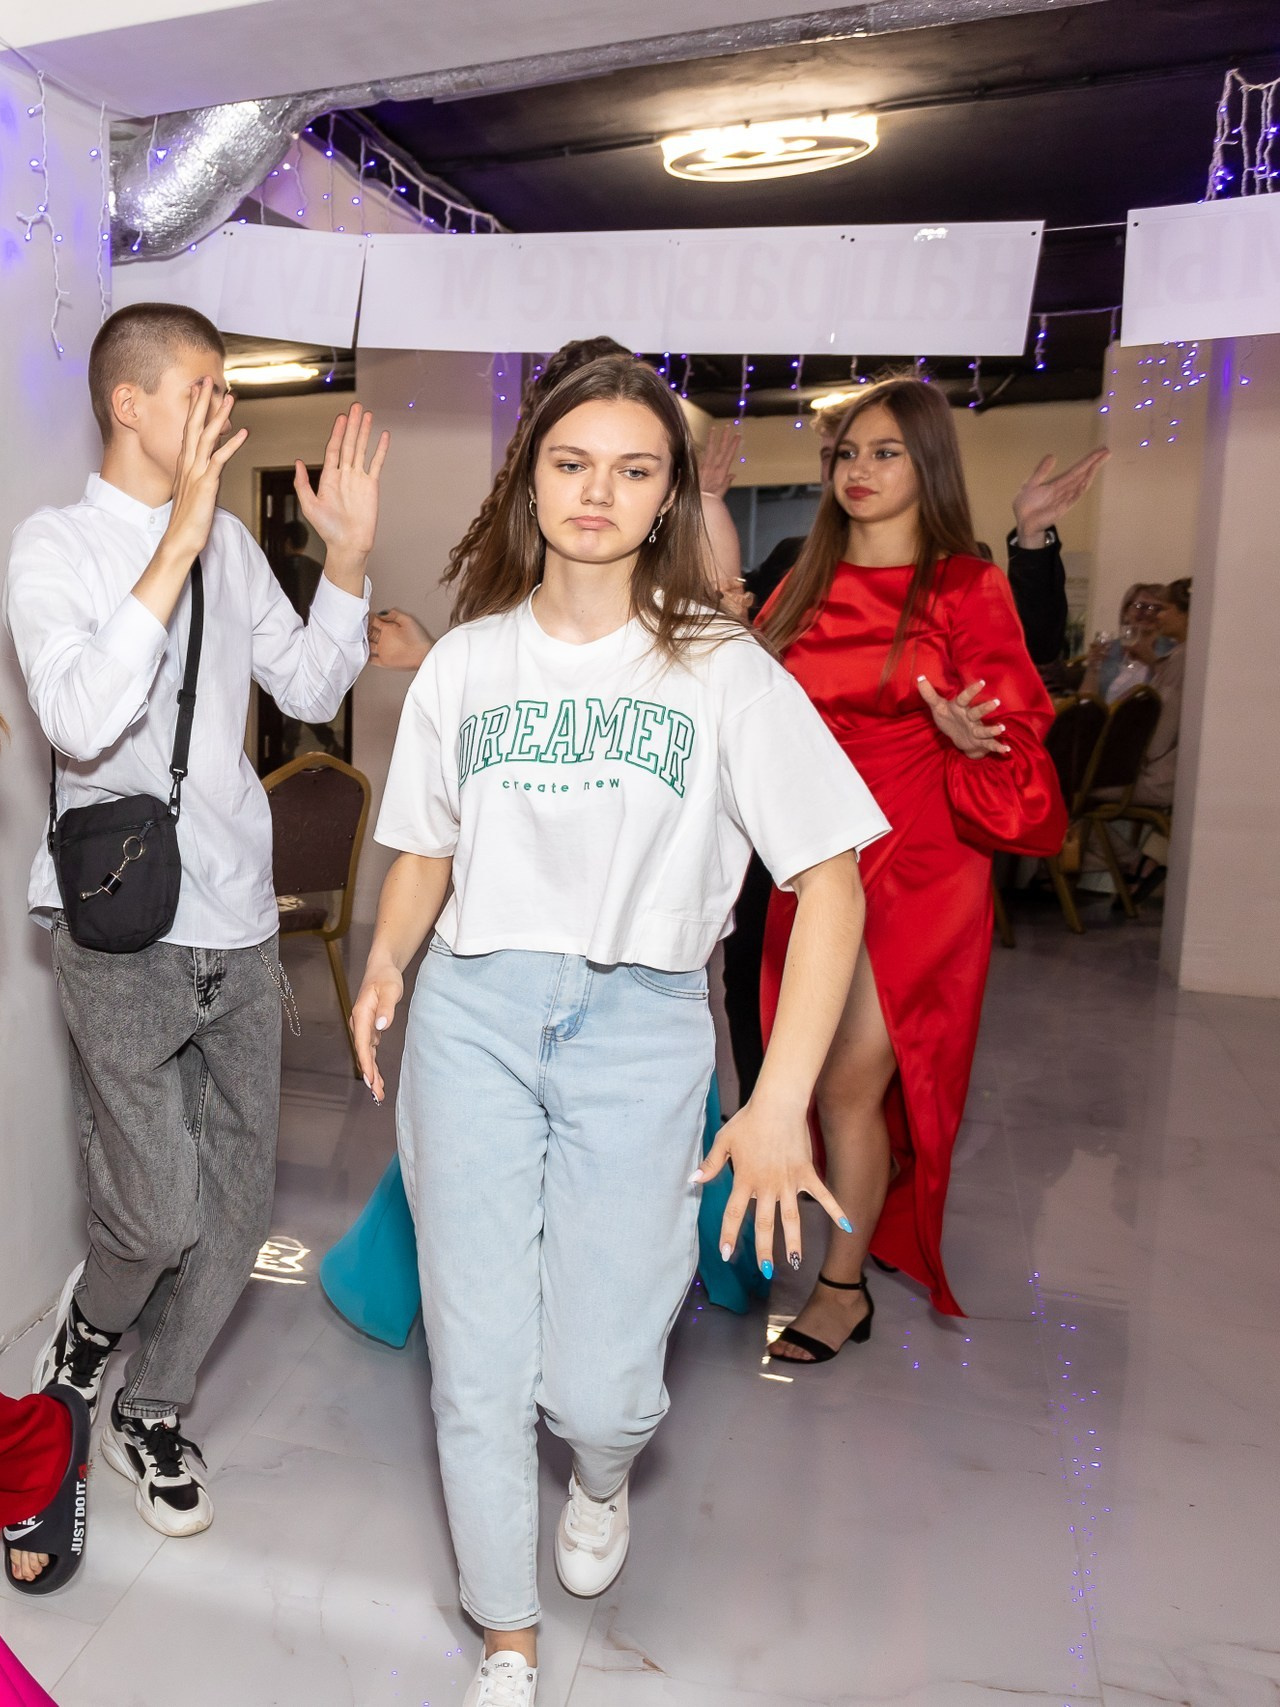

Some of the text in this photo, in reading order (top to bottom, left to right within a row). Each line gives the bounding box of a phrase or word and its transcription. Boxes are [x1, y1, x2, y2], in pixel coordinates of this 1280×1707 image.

[458, 697, 696, 799] DREAMER
[502, 777, 621, 794] create new
[71, 1478, 86, 1556] JUST DO IT.
